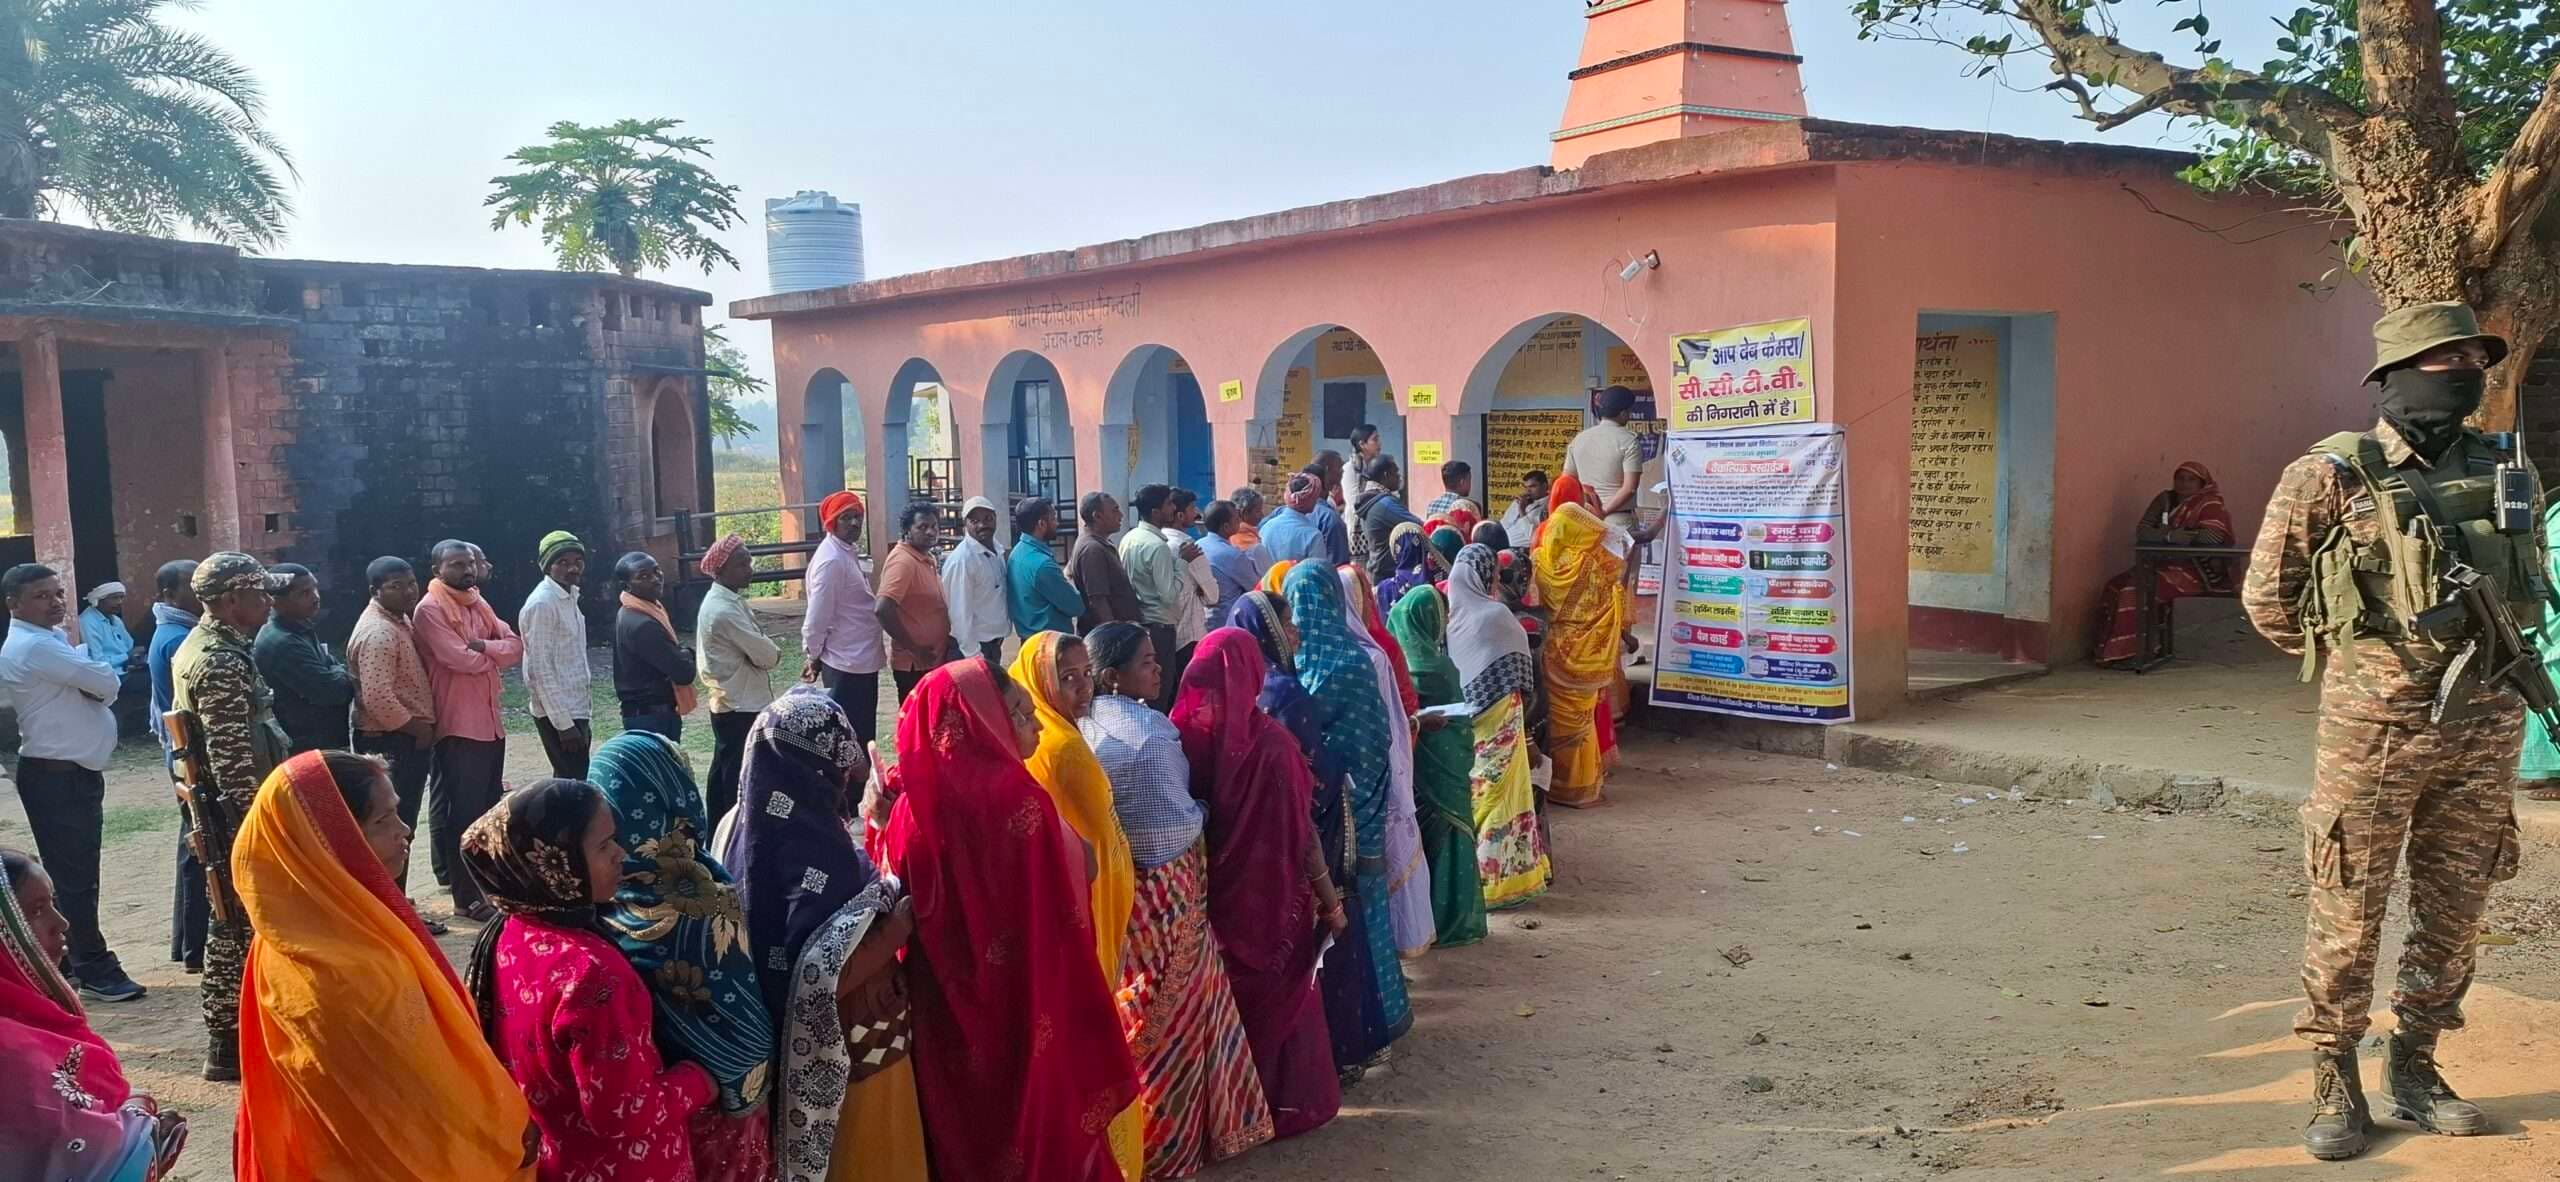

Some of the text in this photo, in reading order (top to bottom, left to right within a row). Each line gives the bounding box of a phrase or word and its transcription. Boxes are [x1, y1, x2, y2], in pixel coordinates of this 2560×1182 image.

[1712, 345, 1736, 365] आप
[1686, 406, 1702, 422] की
[1707, 400, 1758, 421] निगरानी
[1763, 399, 1778, 416] में
